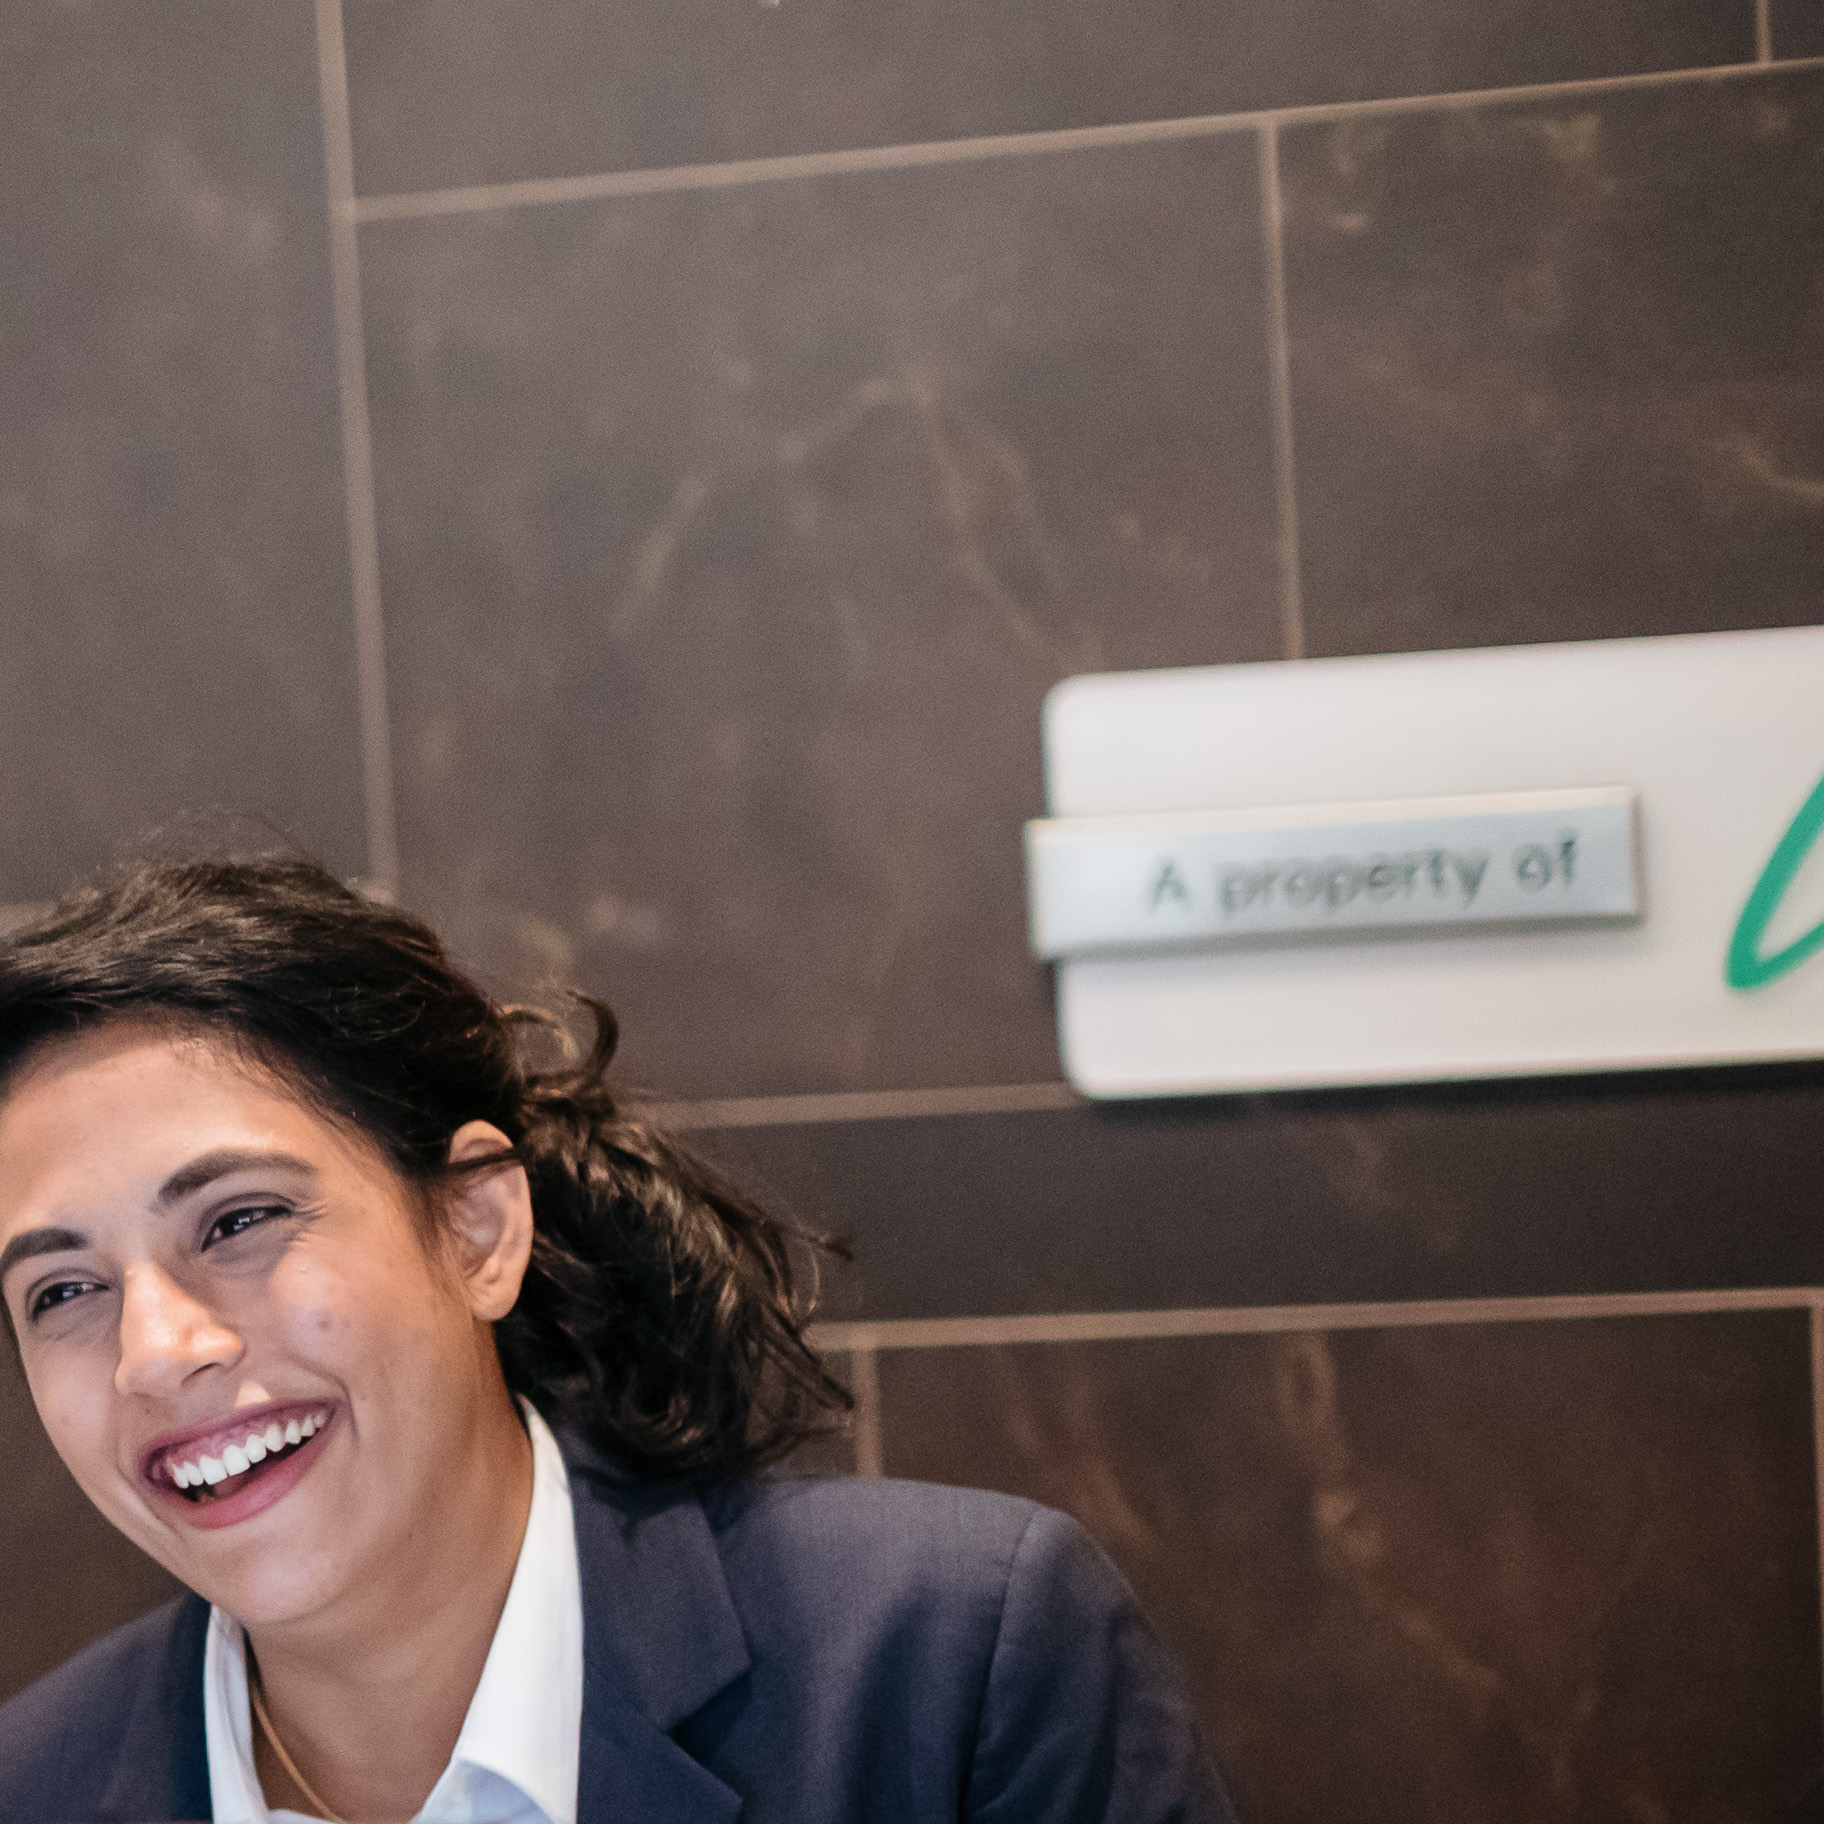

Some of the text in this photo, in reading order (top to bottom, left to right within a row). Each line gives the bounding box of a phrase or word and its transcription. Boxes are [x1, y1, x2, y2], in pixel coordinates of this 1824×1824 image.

[1152, 827, 1579, 919] A property of
